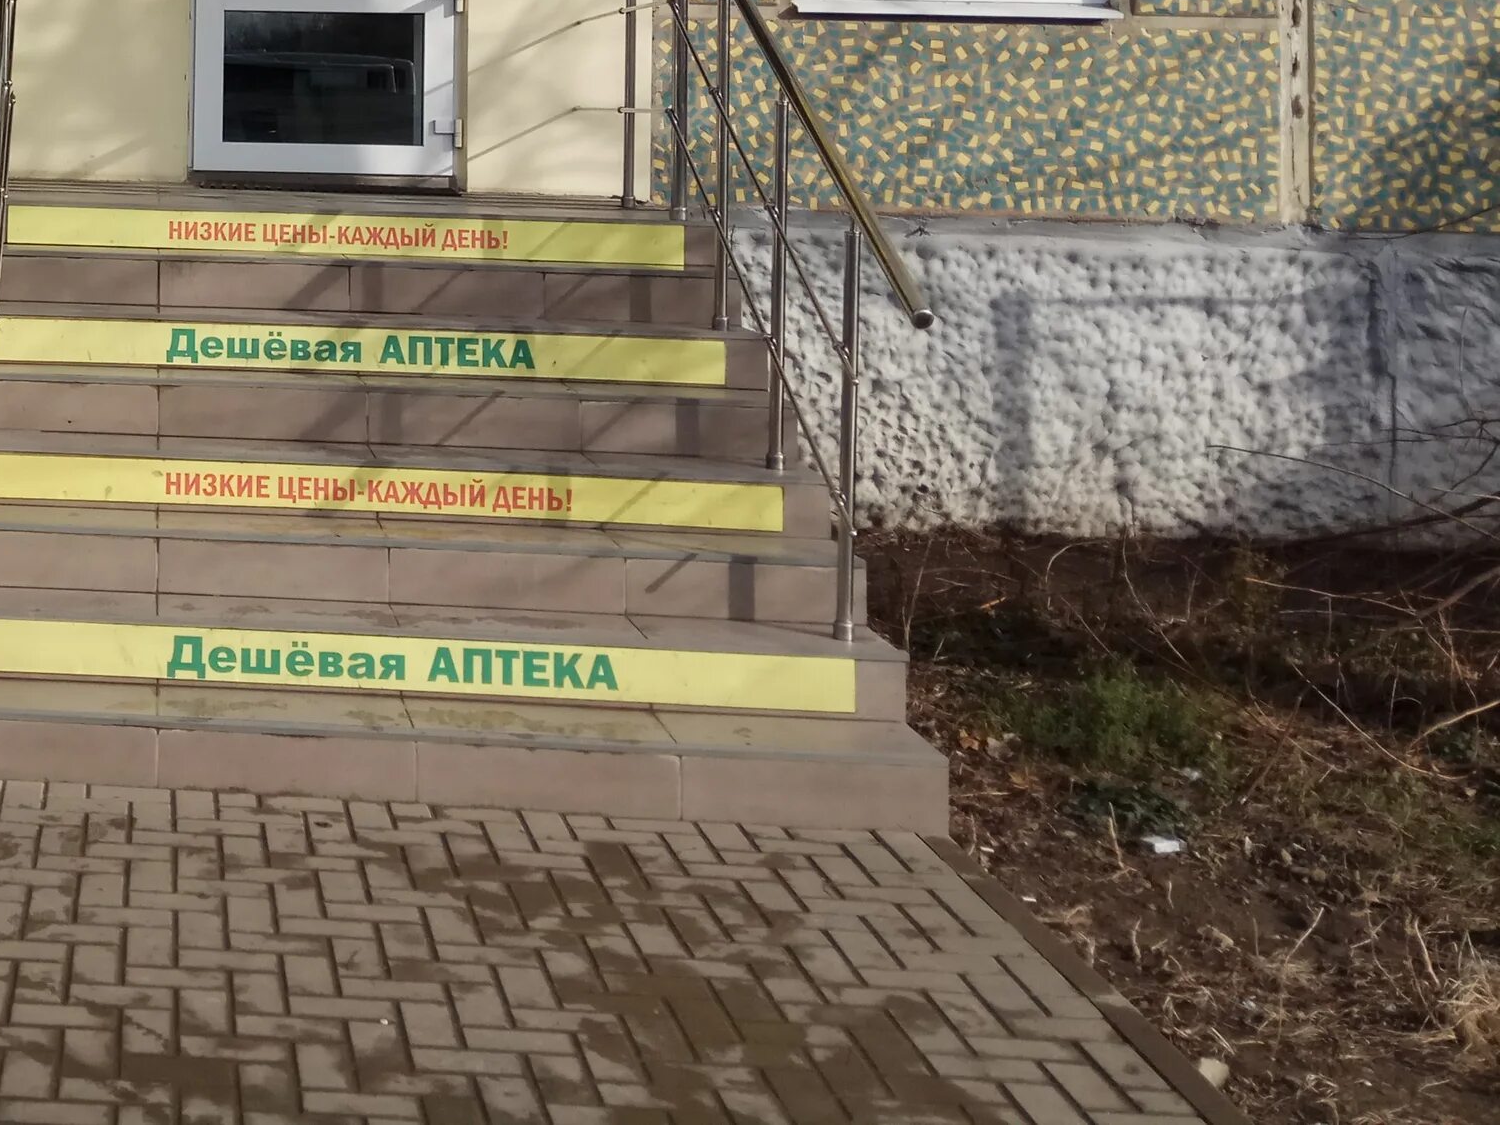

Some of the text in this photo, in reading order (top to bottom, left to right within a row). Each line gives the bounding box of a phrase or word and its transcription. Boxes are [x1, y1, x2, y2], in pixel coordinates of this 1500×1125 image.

[169, 221, 256, 243] НИЗКИЕ
[441, 229, 509, 251] ДЕНЬ!
[166, 328, 536, 370] Дешёвая АПТЕКА
[165, 472, 270, 499] НИЗКИЕ
[492, 485, 574, 514] ДЕНЬ!
[167, 635, 620, 692] Дешёвая АПТЕКА
